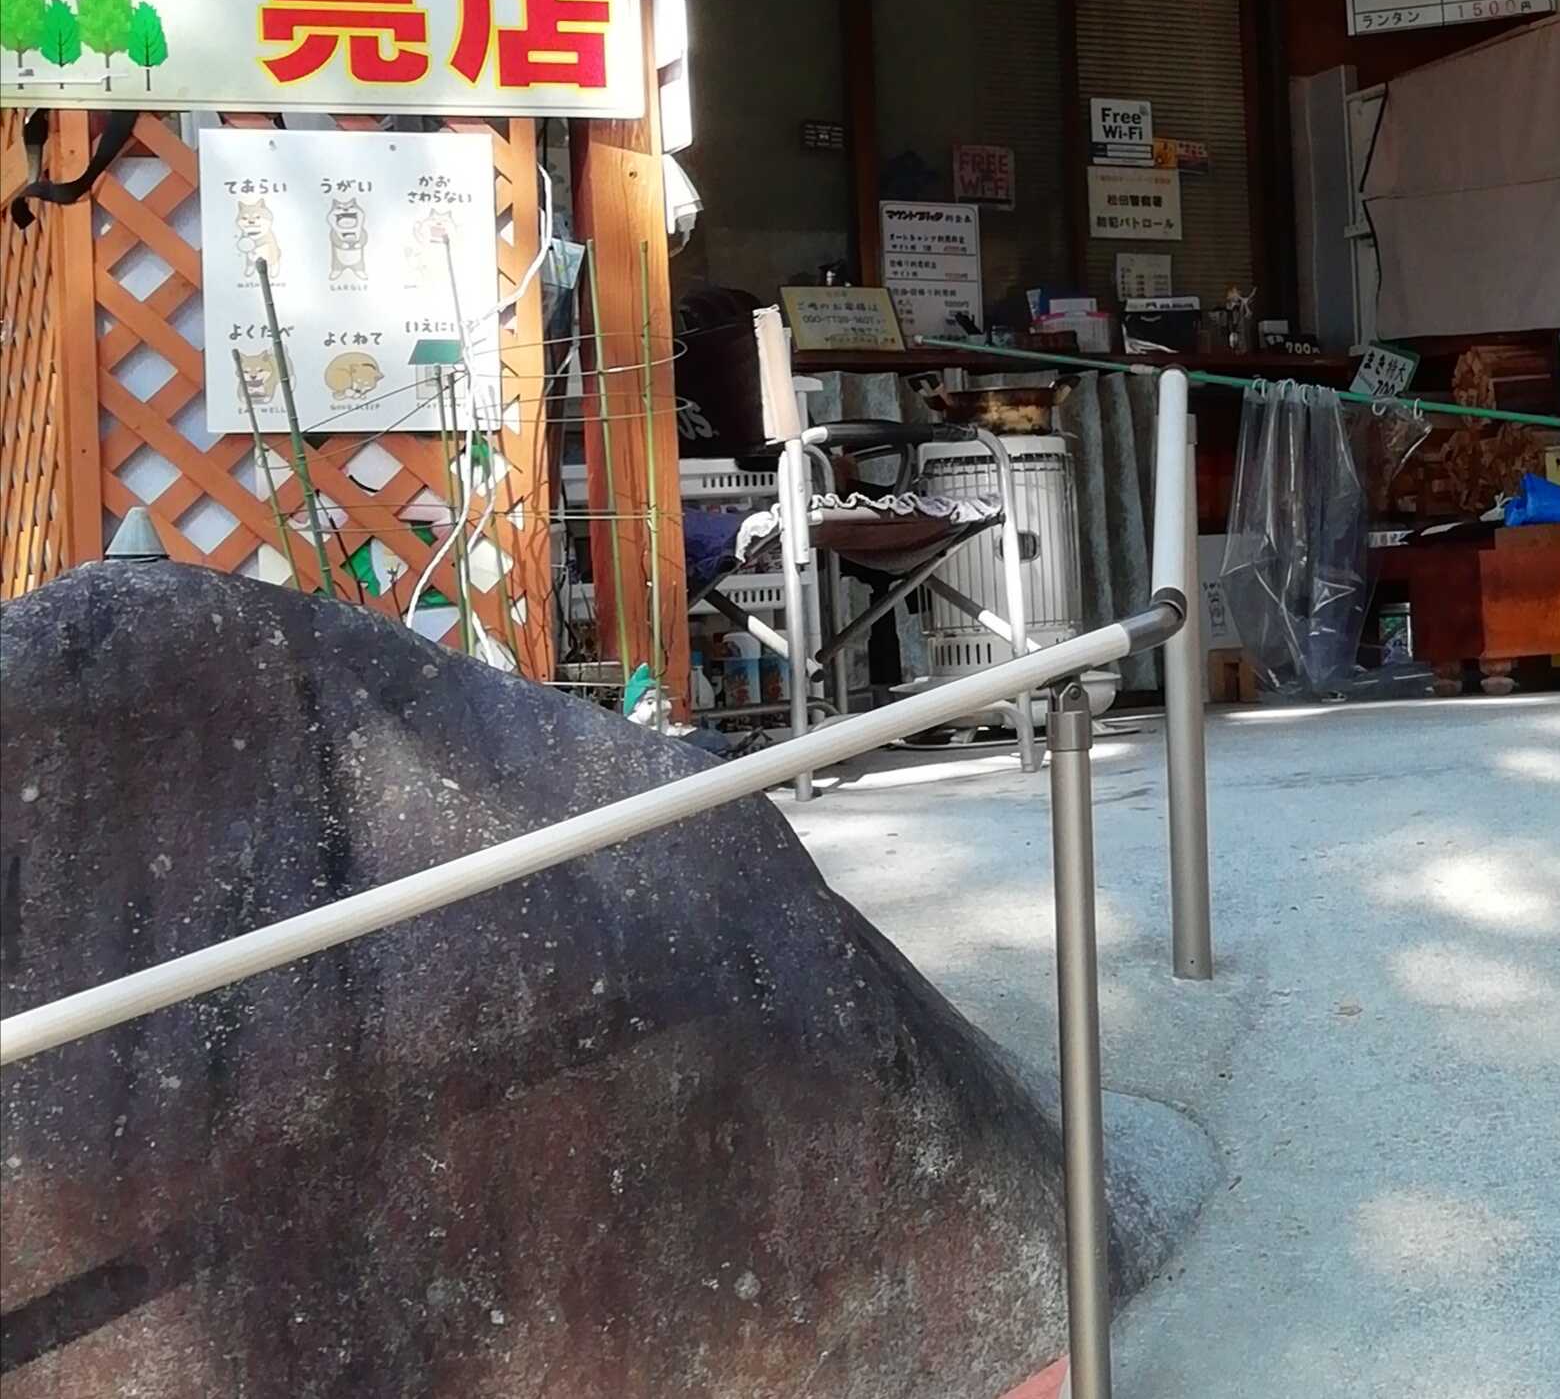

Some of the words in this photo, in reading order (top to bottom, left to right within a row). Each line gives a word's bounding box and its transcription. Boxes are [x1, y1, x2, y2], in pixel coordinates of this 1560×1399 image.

[1362, 10, 1420, 29] ランタン
[1101, 107, 1142, 124] Free
[1102, 125, 1143, 140] Wi-Fi
[223, 179, 288, 194] てあらい
[320, 178, 373, 193] うがい
[418, 175, 451, 187] かお
[407, 191, 473, 204] さわらない
[229, 324, 295, 340] よくたべ
[323, 331, 383, 347] よくねて
